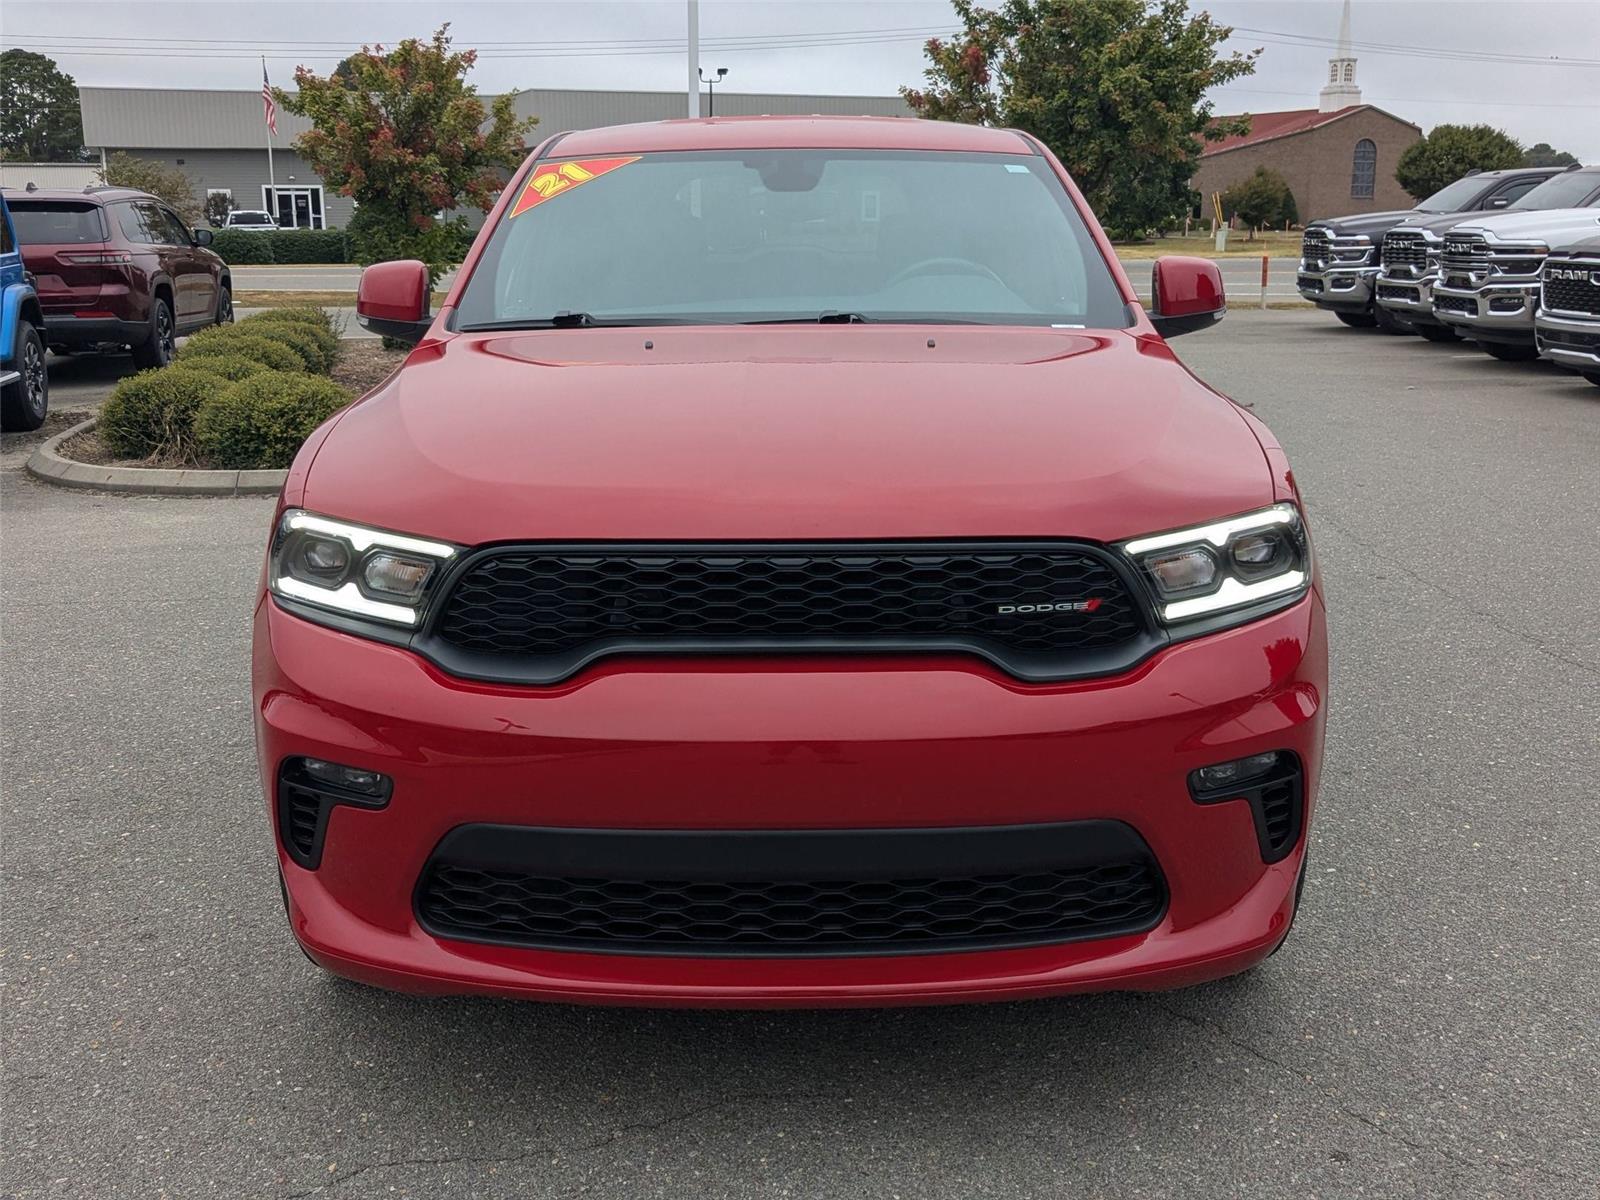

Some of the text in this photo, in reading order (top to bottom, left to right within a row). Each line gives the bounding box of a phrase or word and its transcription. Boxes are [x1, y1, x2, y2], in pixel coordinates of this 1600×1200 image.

[530, 162, 594, 197] 21
[1550, 269, 1588, 281] RAM
[998, 602, 1089, 614] DODGE
